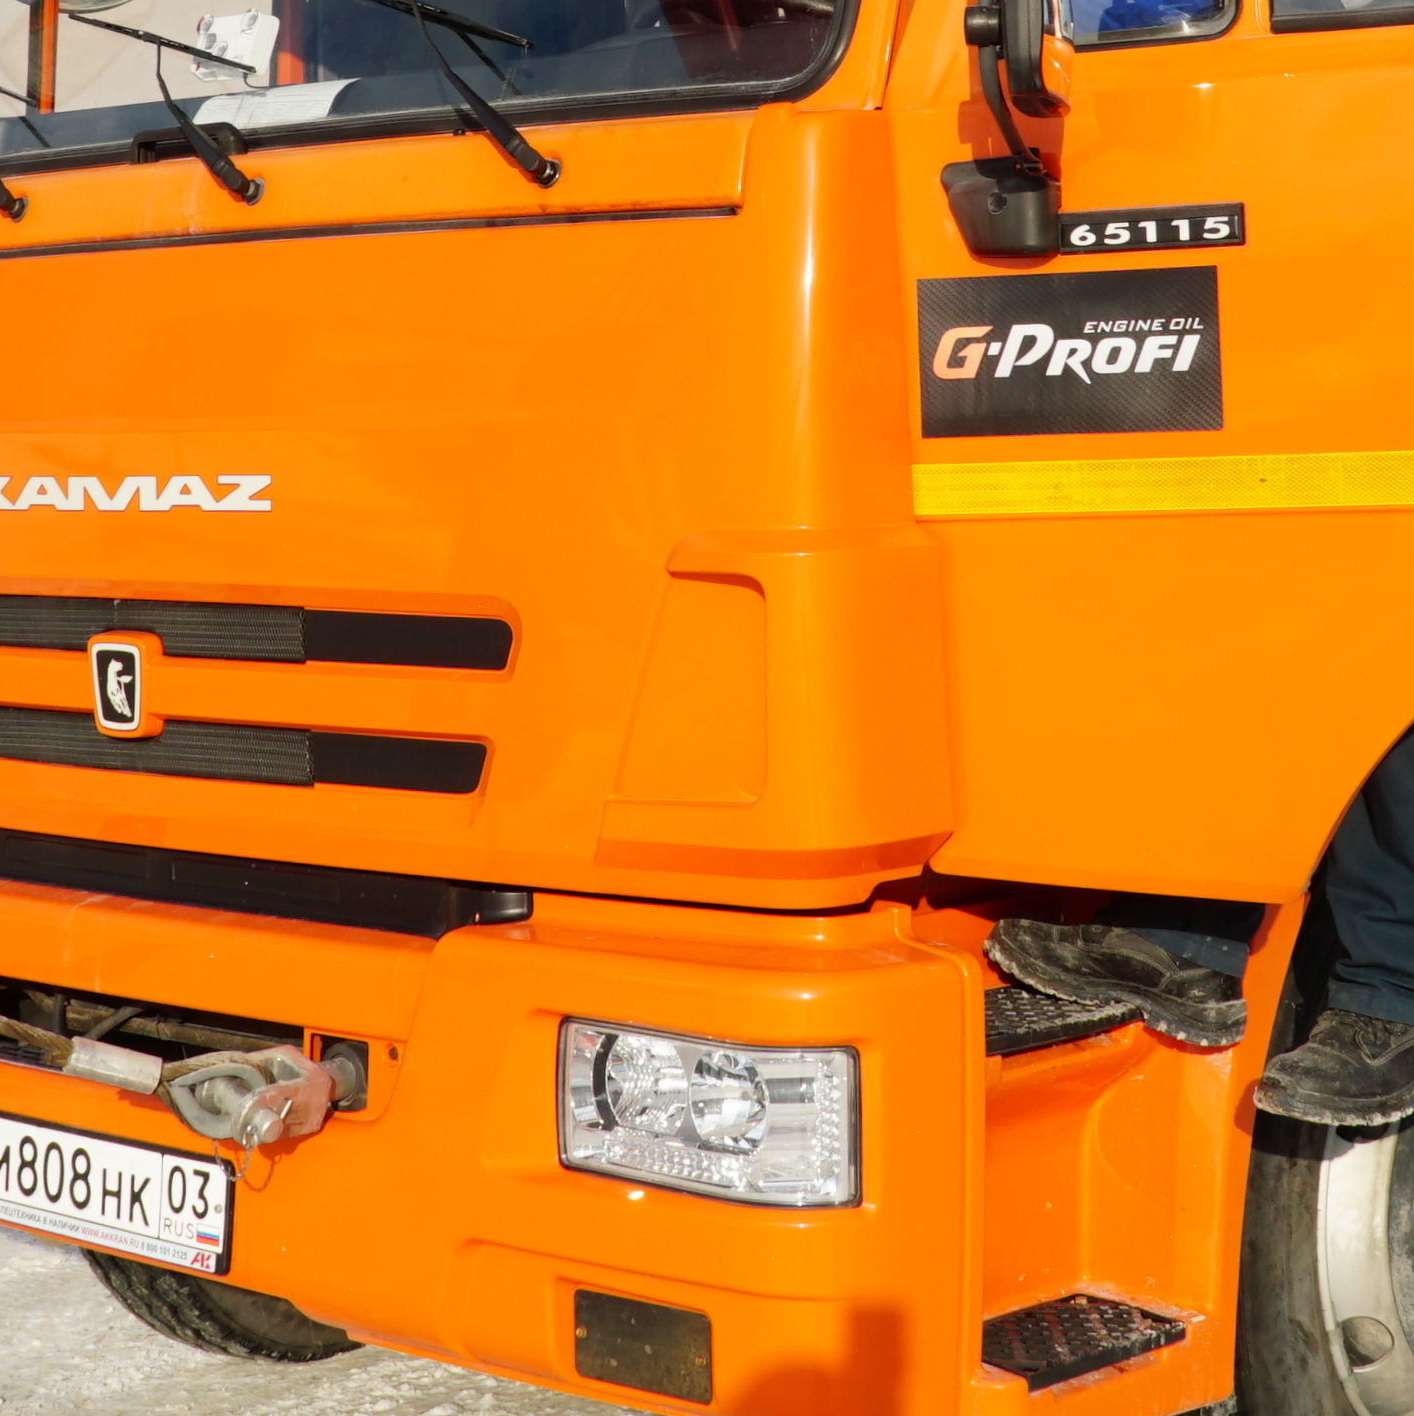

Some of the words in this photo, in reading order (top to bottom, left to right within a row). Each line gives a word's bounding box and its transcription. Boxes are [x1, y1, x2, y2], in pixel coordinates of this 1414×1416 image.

[1070, 216, 1230, 246] 65115
[1083, 319, 1165, 334] ENGINE
[1169, 317, 1204, 331] OIL
[167, 1165, 211, 1220] 03
[49, 1218, 80, 1234] НАЛИЧИИ
[81, 1225, 140, 1248] WWW.AKKRAN.RU
[146, 1242, 159, 1253] 800
[160, 1245, 171, 1257] 101
[172, 1248, 188, 1261] 2125
[163, 1217, 195, 1240] RUS
